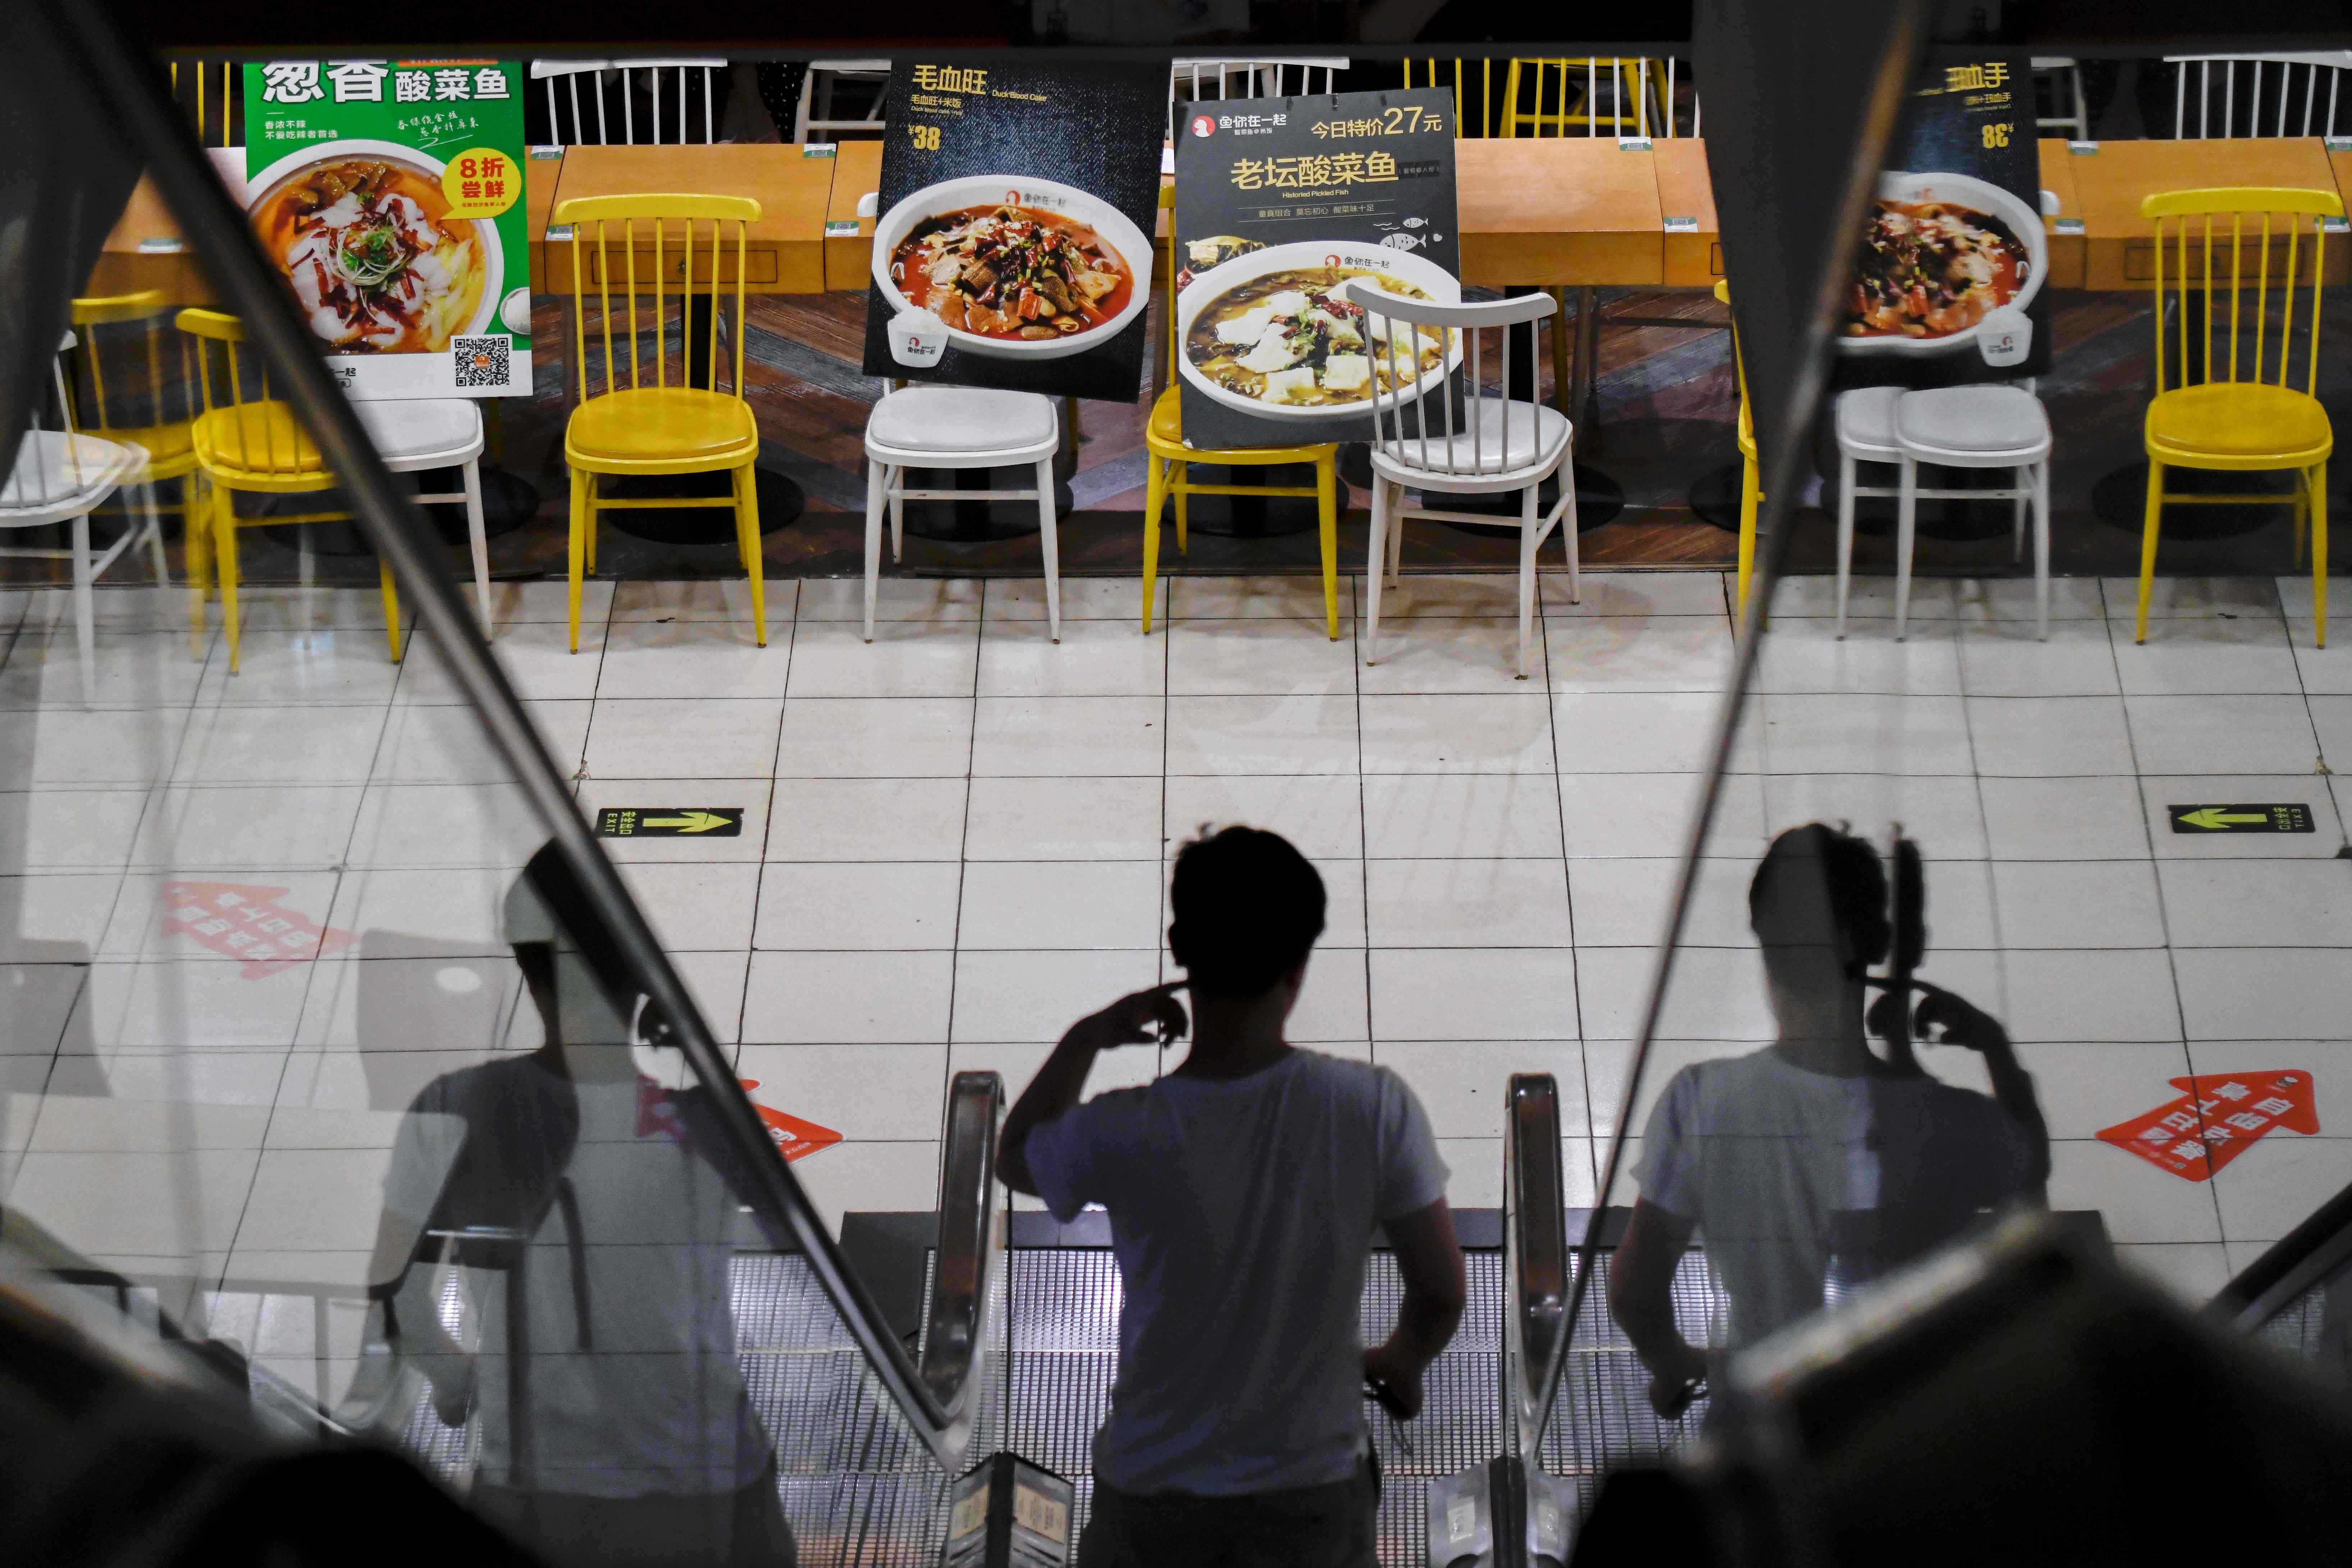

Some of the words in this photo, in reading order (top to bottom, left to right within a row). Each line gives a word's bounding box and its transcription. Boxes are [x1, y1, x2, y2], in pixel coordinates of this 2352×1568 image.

[395, 68, 510, 102] 酸菜鱼
[912, 65, 988, 95] 毛血旺
[911, 94, 962, 108] 毛血旺+米饭
[265, 120, 306, 130] 香浓不辣
[1220, 114, 1287, 129] 鱼你在一起
[1311, 106, 1442, 139] 今日特价27元
[265, 129, 338, 140] 不爱吃辣者首选
[460, 157, 505, 178] 8折
[1231, 151, 1399, 190] 老坛酸菜鱼
[462, 180, 505, 198] 尝鲜
[605, 813, 618, 832] EXIT
[619, 812, 636, 834] 安全出口
